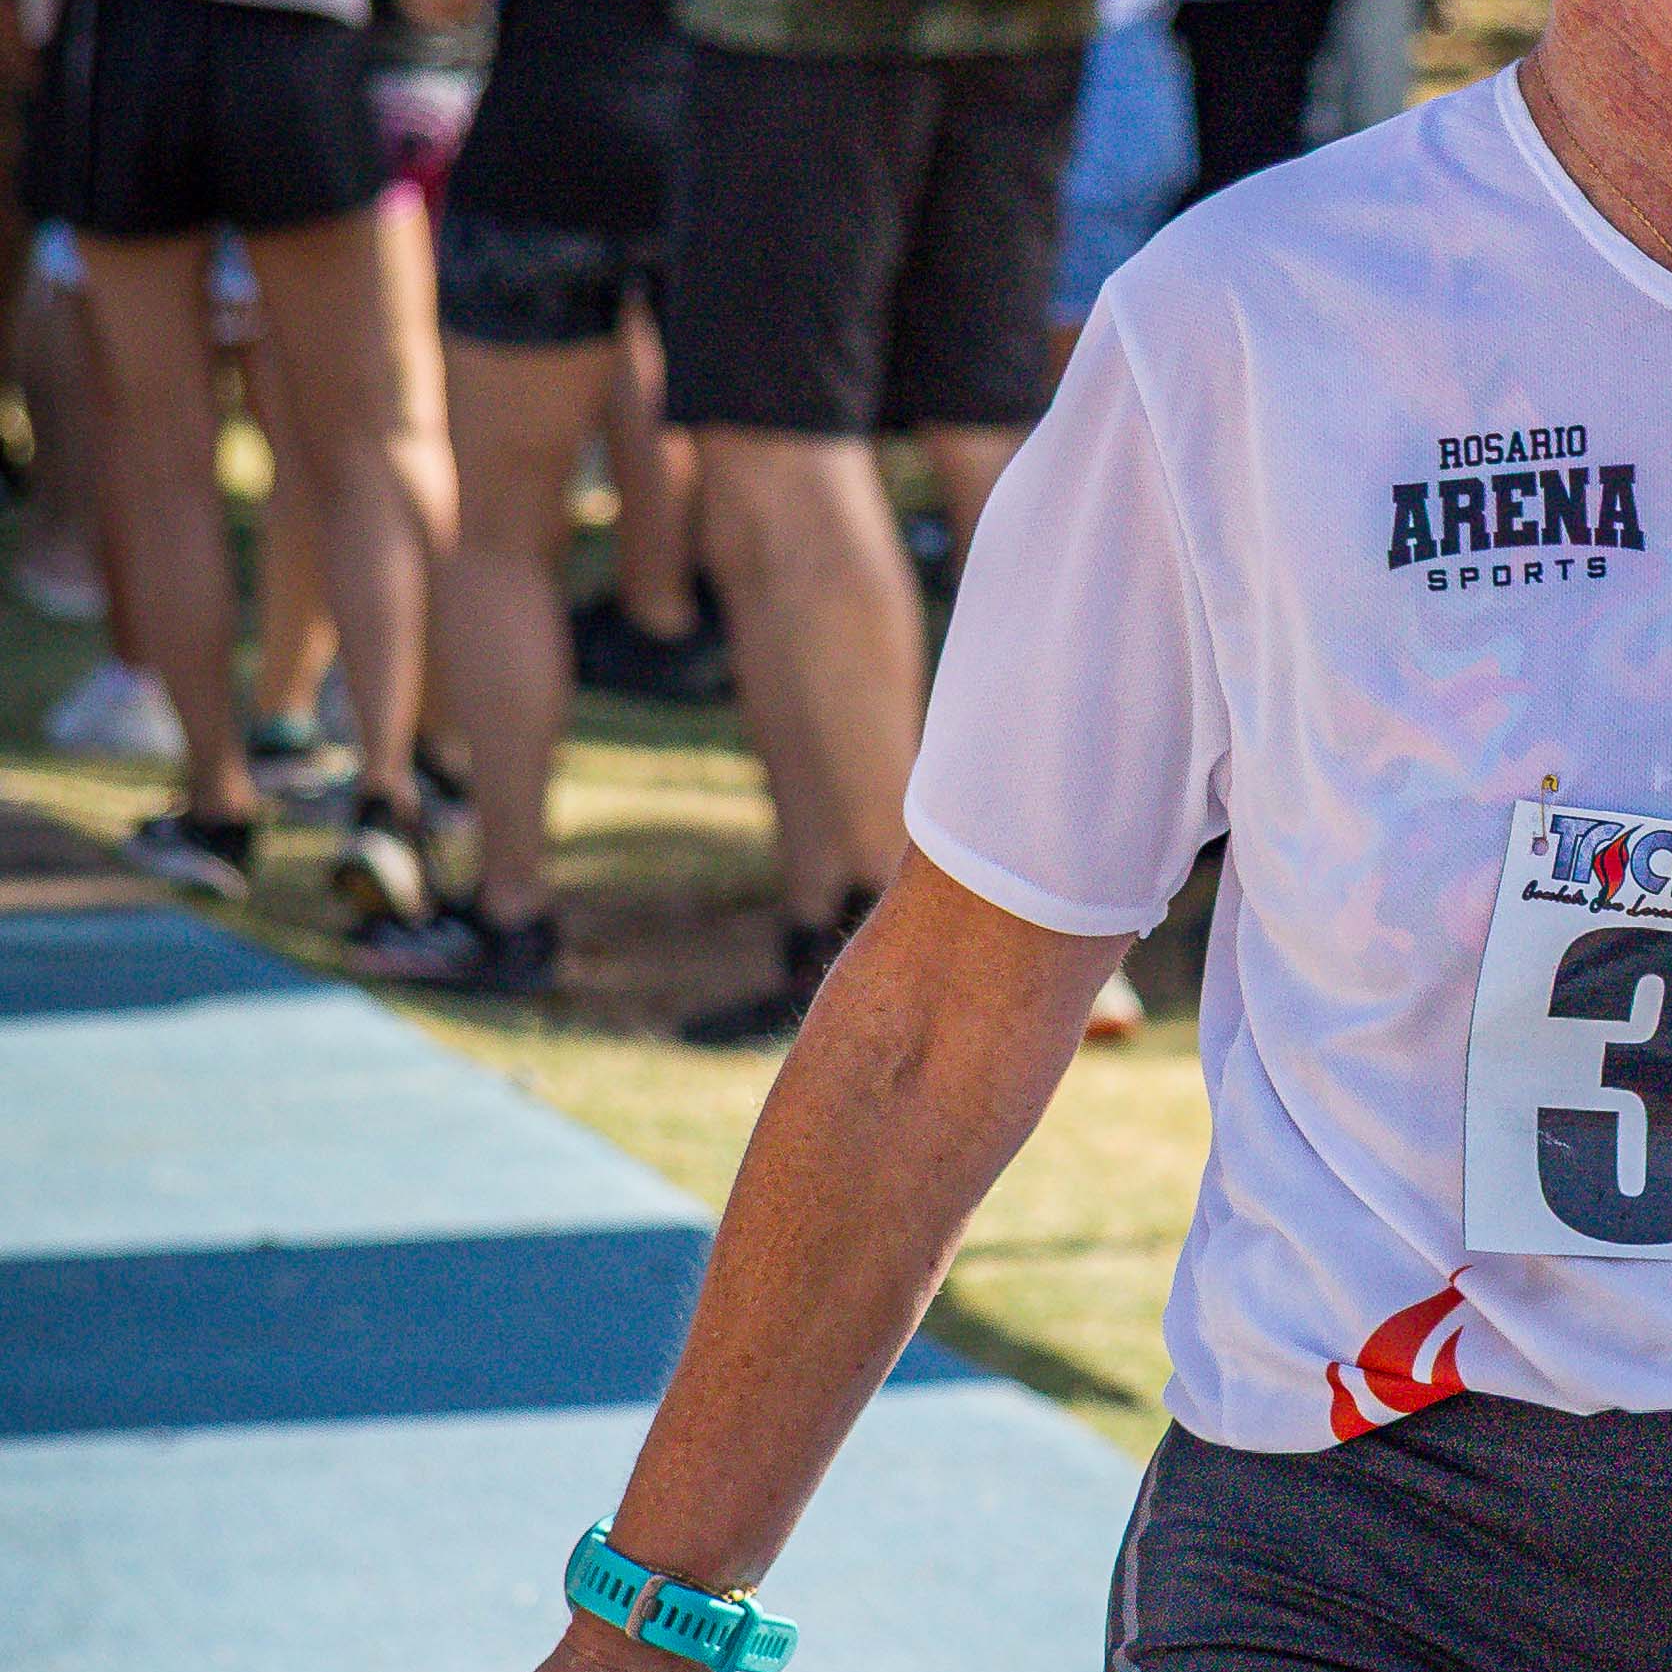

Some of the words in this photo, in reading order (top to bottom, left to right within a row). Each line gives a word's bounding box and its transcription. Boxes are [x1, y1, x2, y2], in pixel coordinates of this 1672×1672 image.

[1438, 424, 1587, 470] ROSARIO
[1388, 463, 1646, 570] ARENA
[1427, 556, 1607, 592] SPORTS
